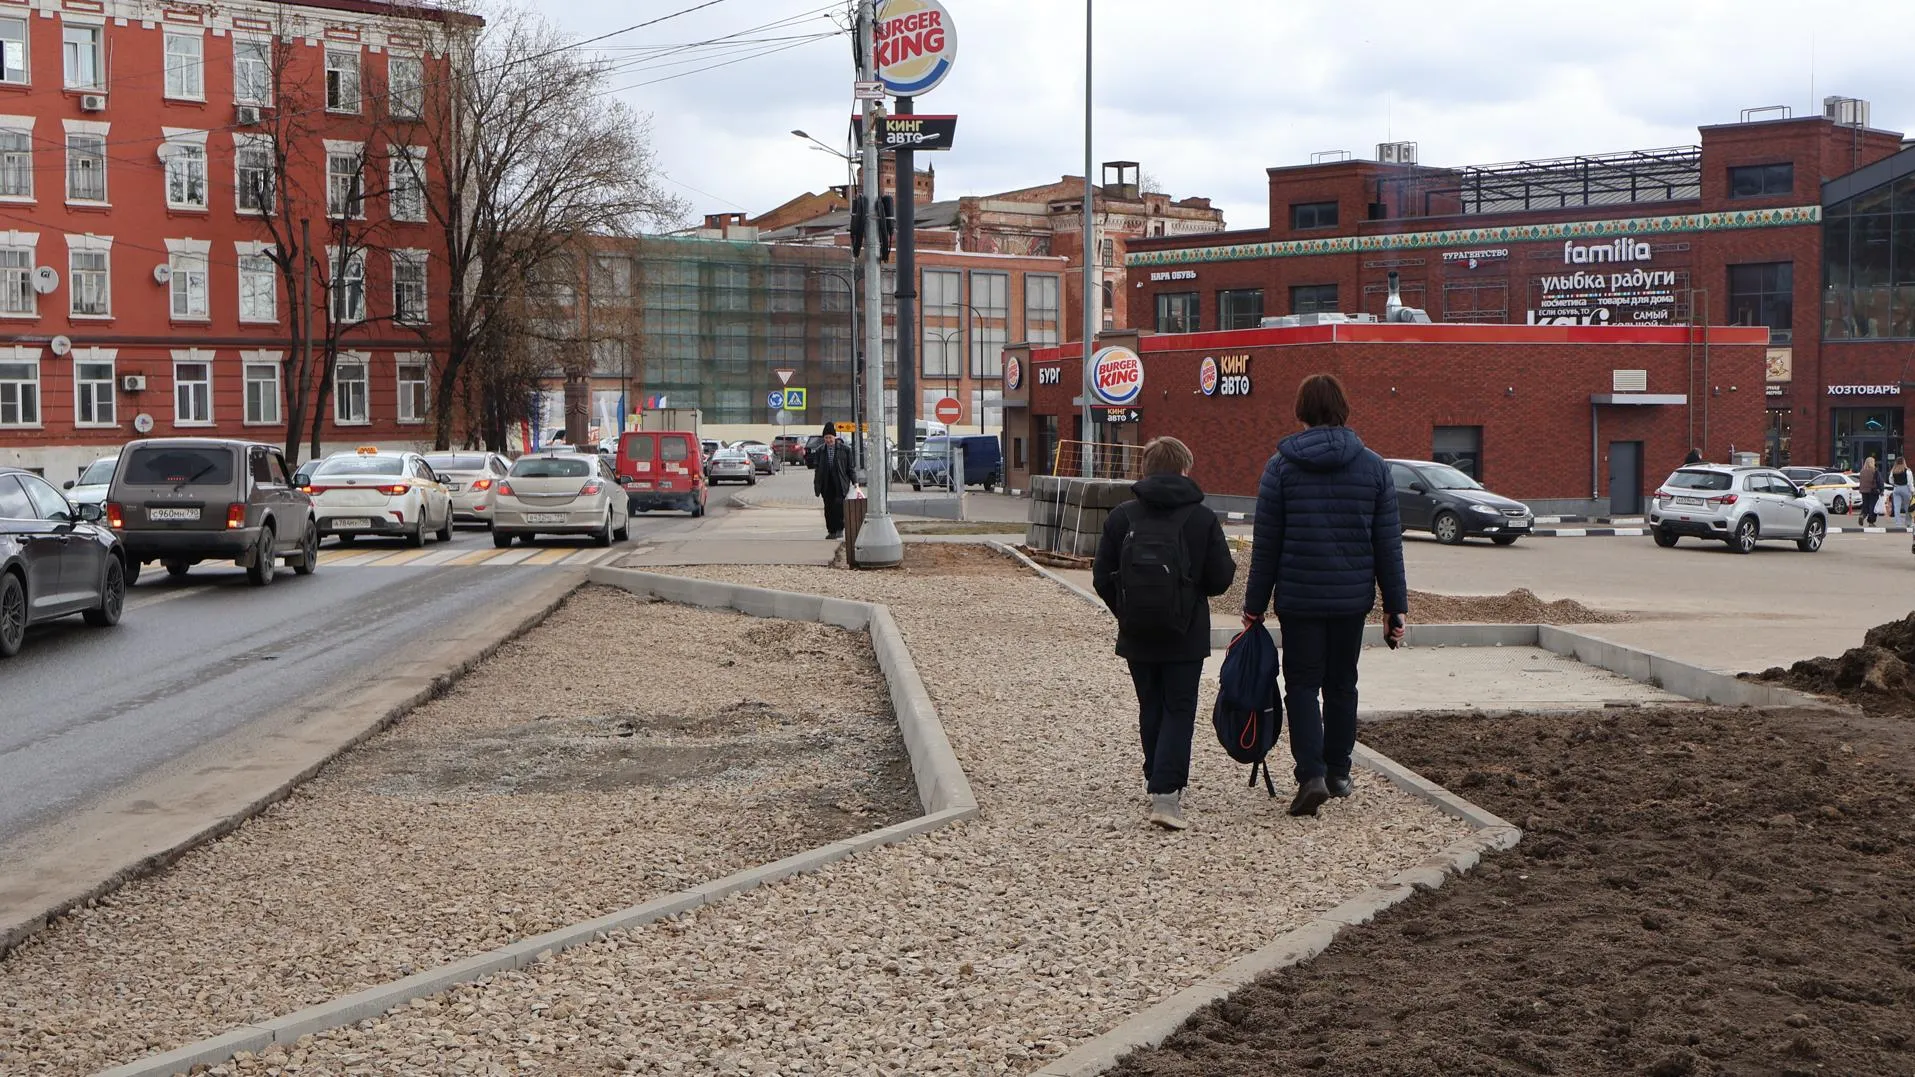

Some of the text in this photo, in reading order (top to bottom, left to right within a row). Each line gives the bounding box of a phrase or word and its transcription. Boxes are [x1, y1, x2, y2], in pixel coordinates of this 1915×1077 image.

[873, 10, 942, 41] URGER
[873, 28, 945, 70] KING
[886, 120, 923, 131] КИНГ
[1442, 249, 1508, 260] ТУРАГЕНТСТВО
[1565, 237, 1652, 264] familia
[1172, 270, 1196, 279] ОБУВЬ
[1541, 269, 1675, 294] улыбка радуги
[1541, 295, 1674, 307] косметика товары для дома
[1633, 309, 1668, 320] САМЫЙ
[1100, 360, 1137, 375] BURGER
[1221, 355, 1249, 374] КИНГ
[1039, 367, 1060, 384] БУРГ
[1100, 369, 1138, 388] KING
[1827, 385, 1900, 395] ХОЗТОВАРЫ
